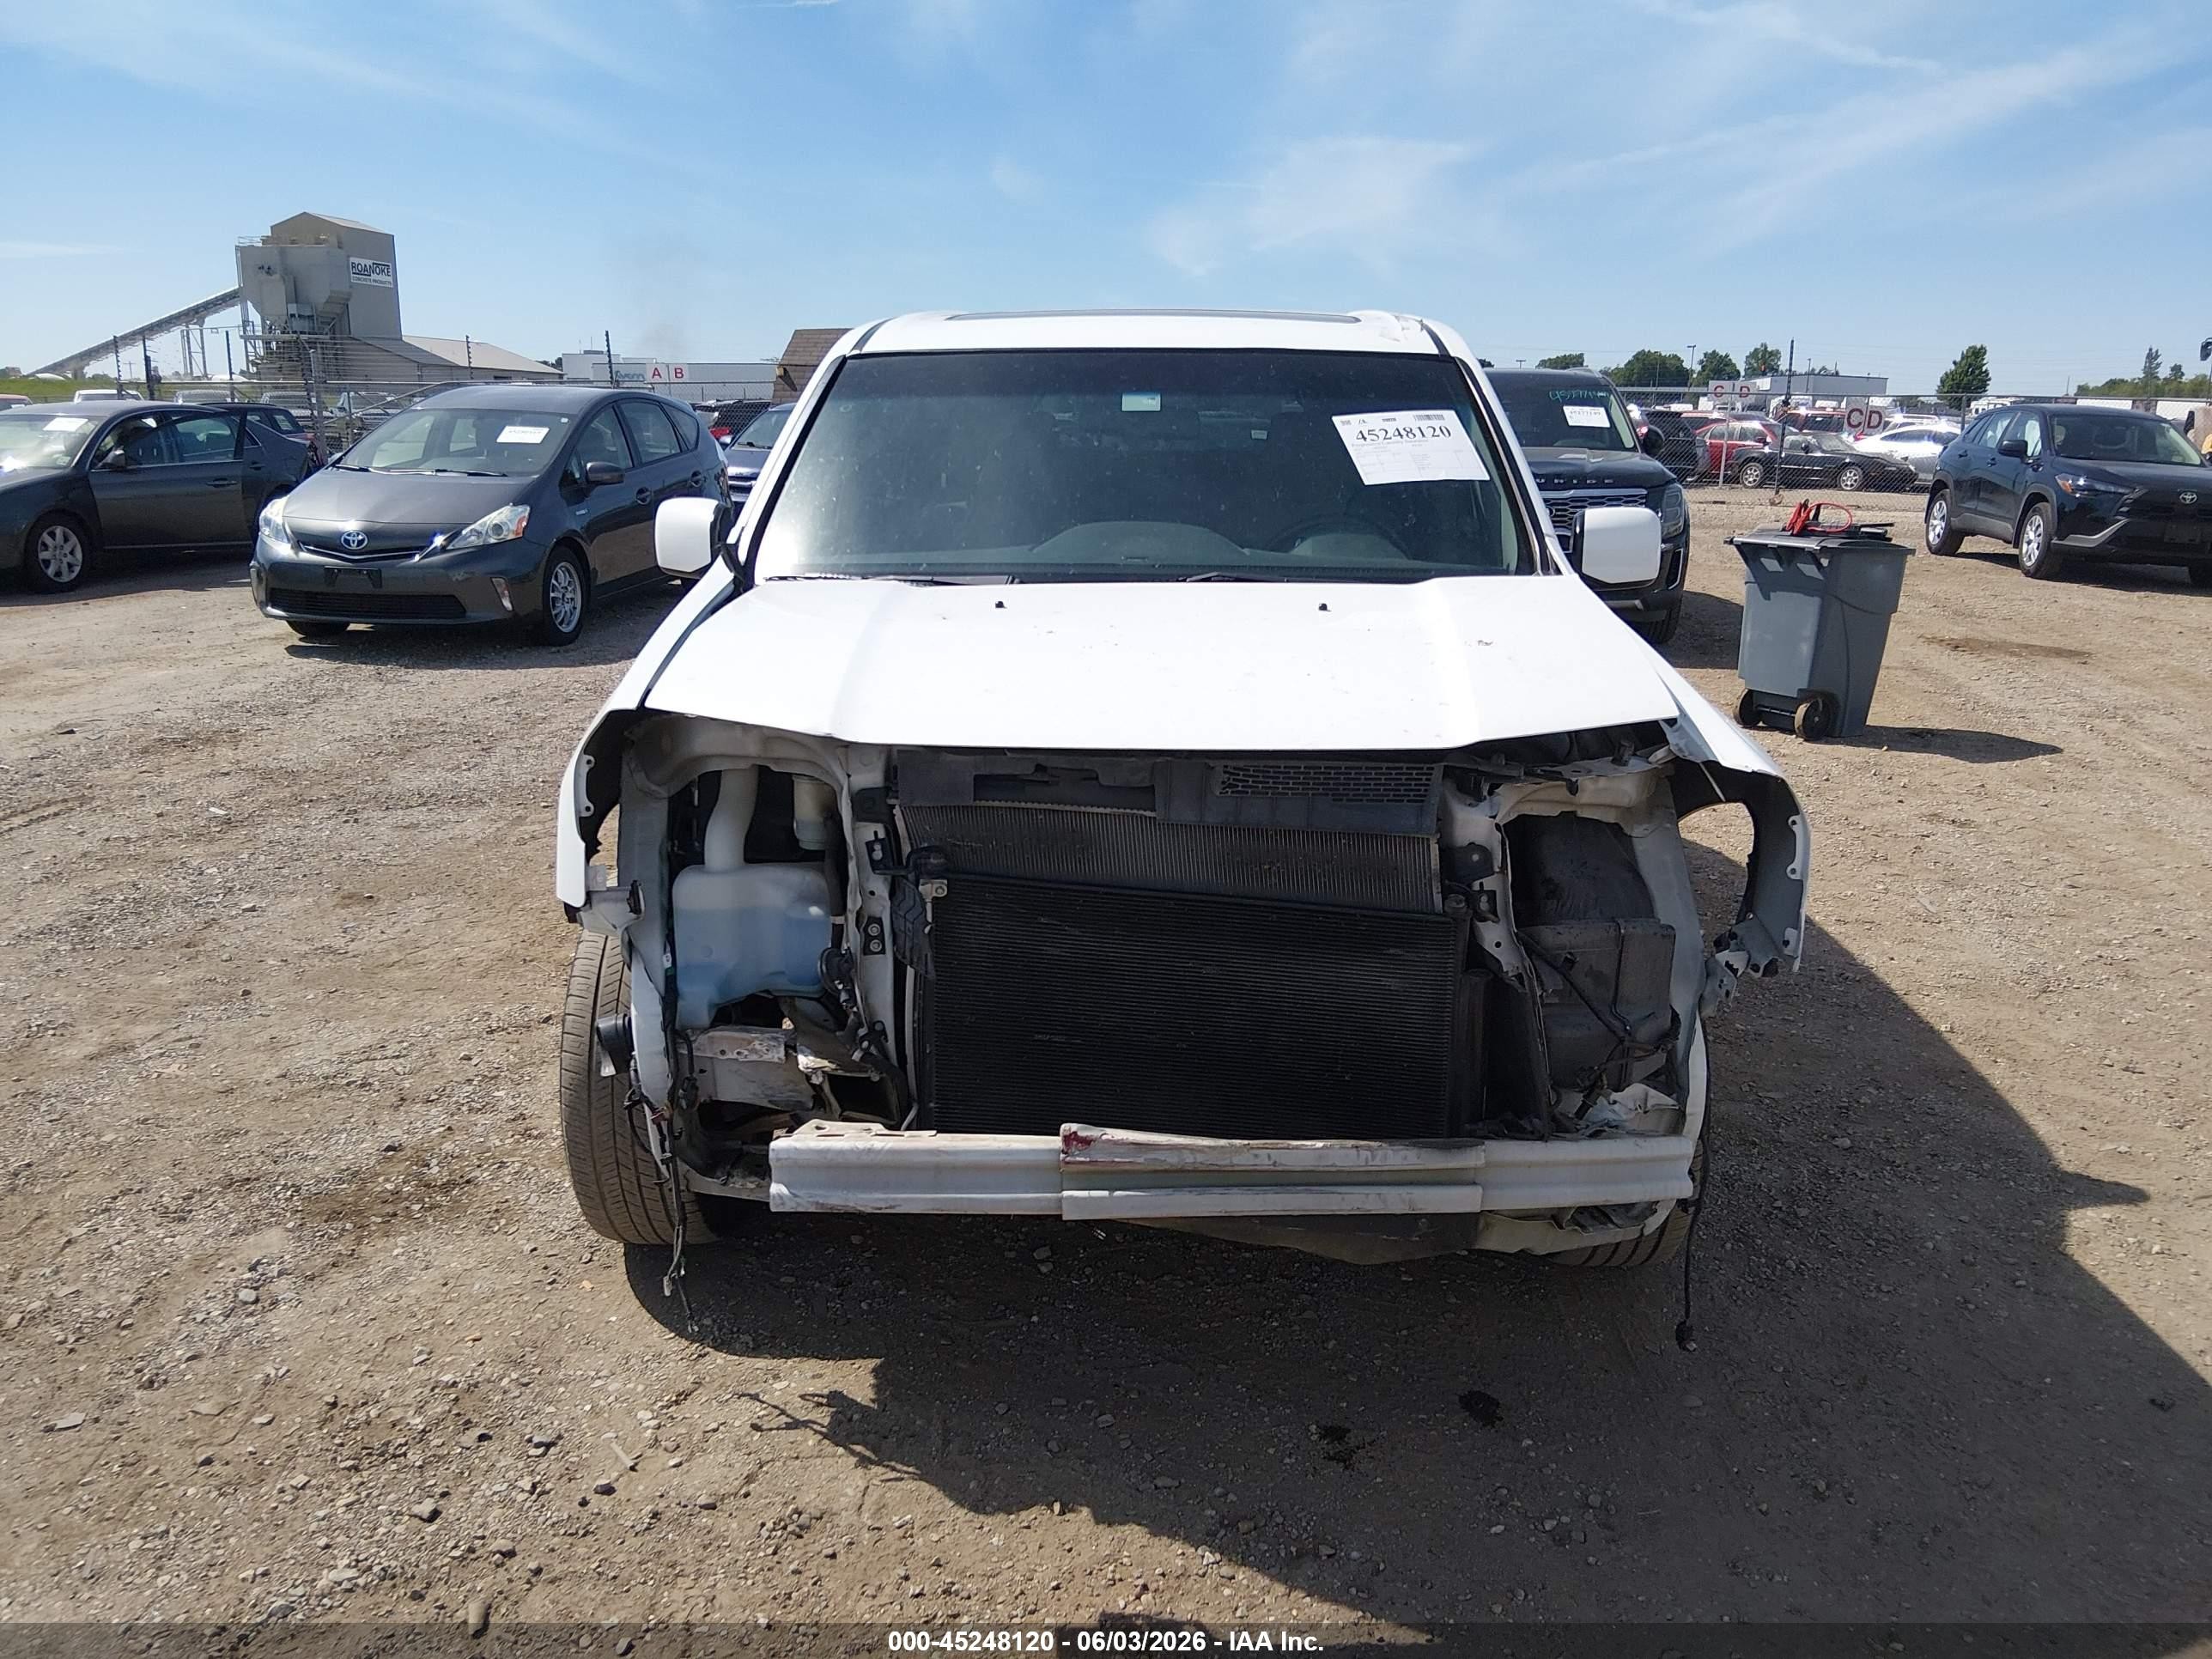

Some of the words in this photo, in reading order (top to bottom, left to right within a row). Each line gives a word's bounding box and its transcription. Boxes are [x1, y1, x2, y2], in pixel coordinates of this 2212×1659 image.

[351, 261, 392, 276] ROANOKE
[652, 367, 662, 379] A
[674, 367, 684, 379] B
[1713, 385, 1725, 398] C
[1739, 386, 1751, 398] D
[1846, 408, 1864, 429] C
[1868, 410, 1883, 429] D
[1356, 425, 1451, 441] 45248120
